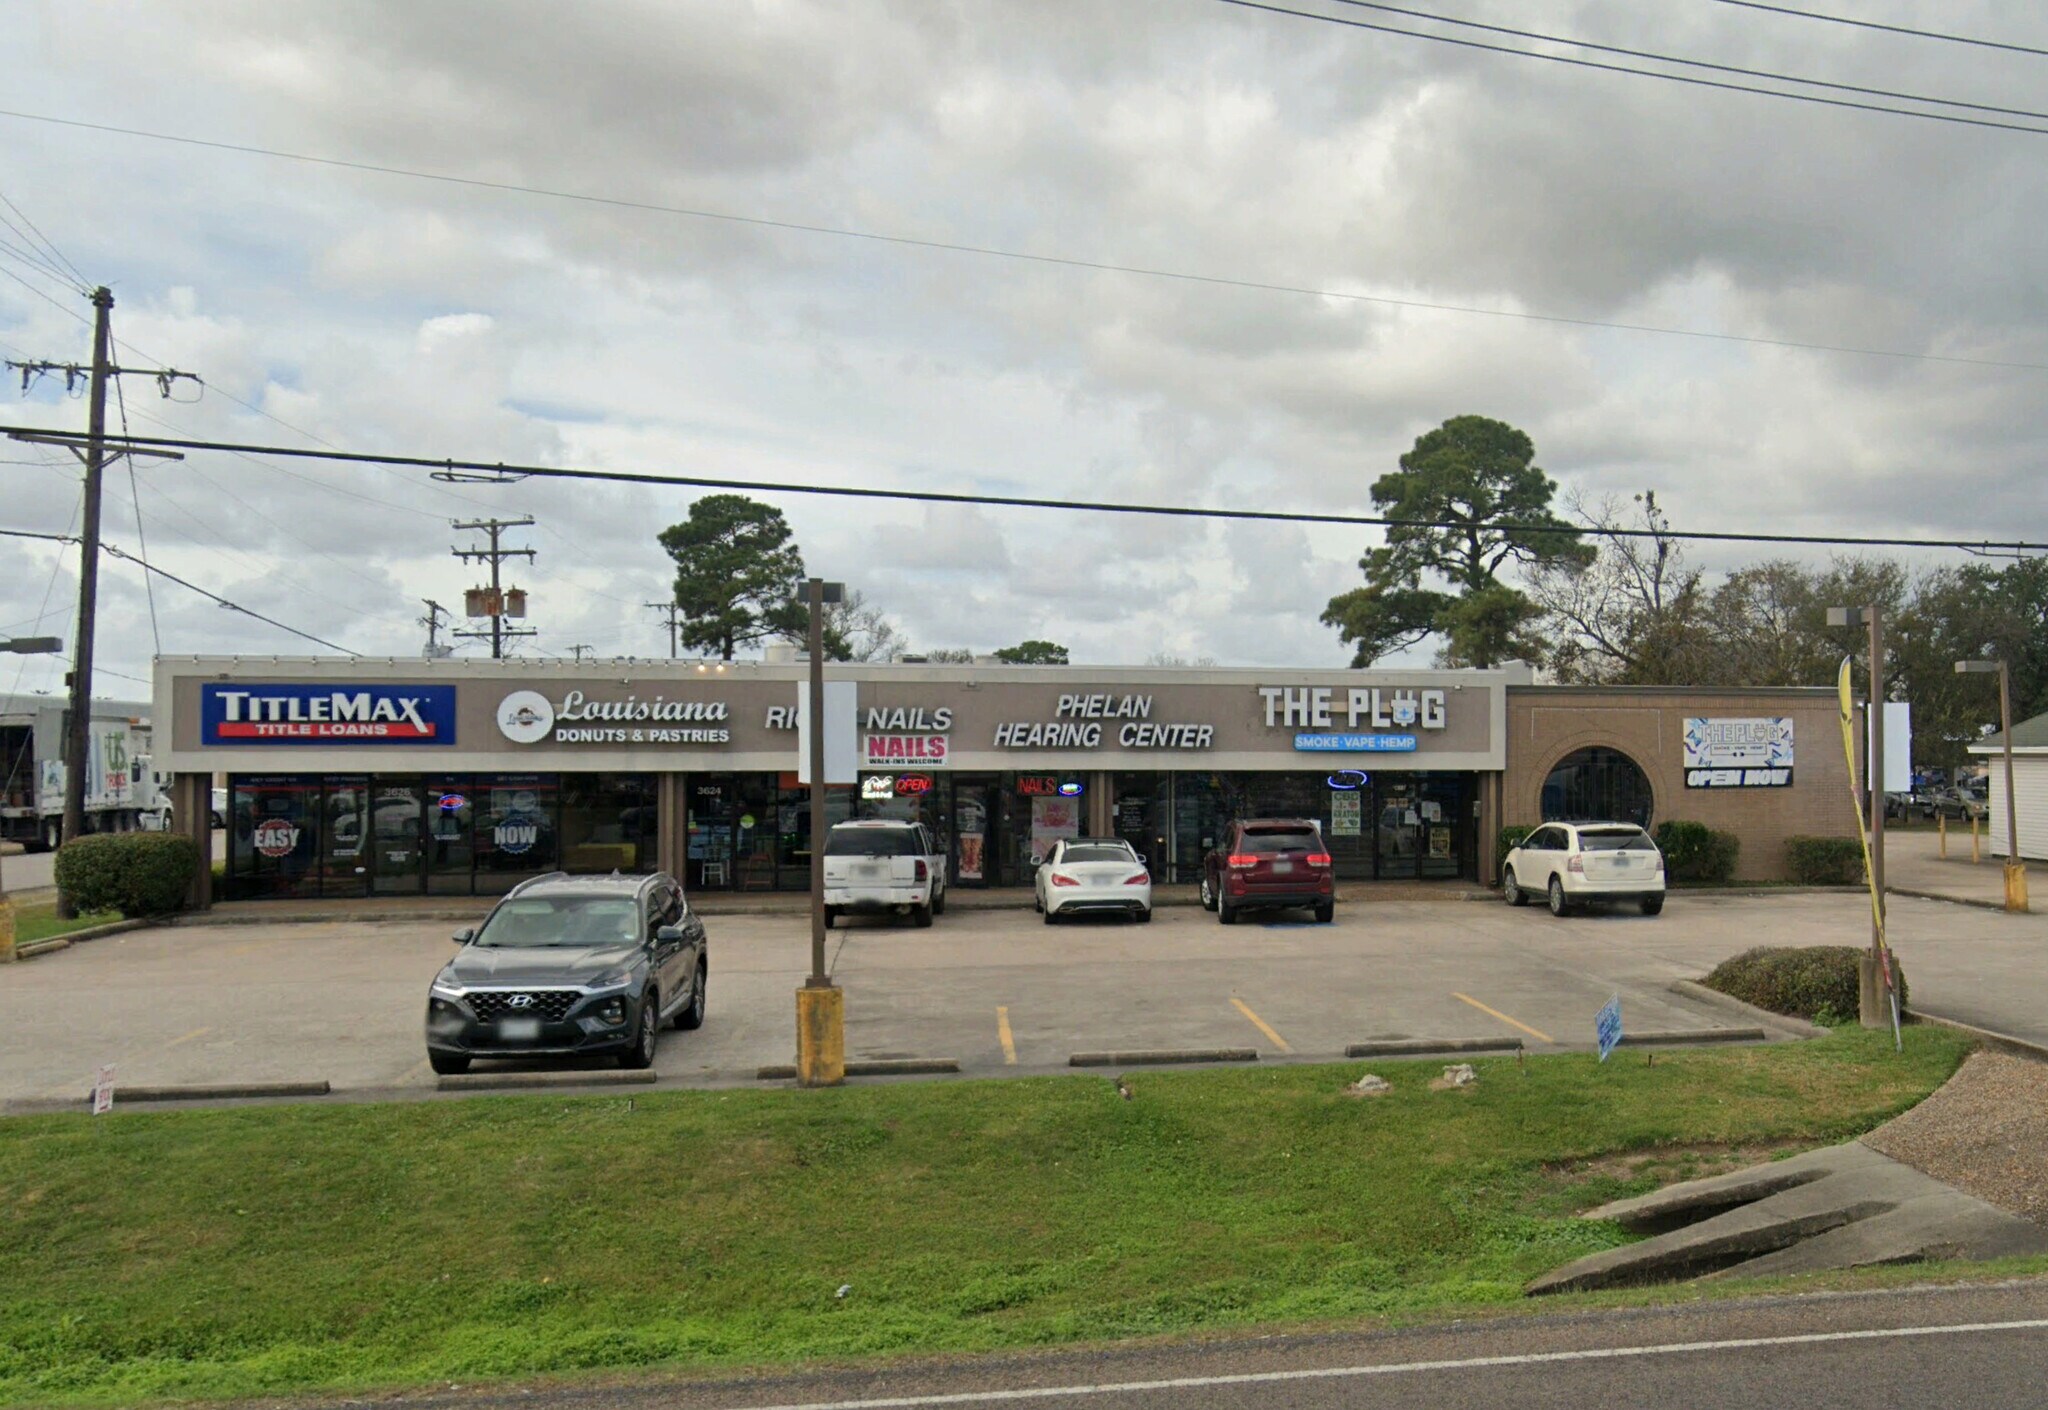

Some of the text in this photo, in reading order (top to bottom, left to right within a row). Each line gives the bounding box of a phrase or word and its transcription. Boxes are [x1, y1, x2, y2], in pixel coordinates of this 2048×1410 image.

[556, 690, 728, 721] Louisiana
[1056, 693, 1152, 718] PHELAN
[1258, 687, 1445, 728] THE PLUG
[866, 706, 953, 731] NAILS
[255, 723, 388, 736] TITLE LOANS
[556, 728, 730, 743] DONUTS & PASTRIES
[993, 722, 1214, 748] HEARING CENTER
[1699, 723, 1733, 743] THE
[868, 736, 945, 758] NAILS
[1295, 735, 1415, 749] SMOKE VAPE HEMP
[897, 778, 929, 792] OPEN
[1019, 777, 1055, 794] NAILS
[1687, 769, 1790, 787] OPEN NOW
[697, 786, 722, 795] 3624
[253, 828, 301, 848] EASY
[494, 826, 538, 845] NOW
